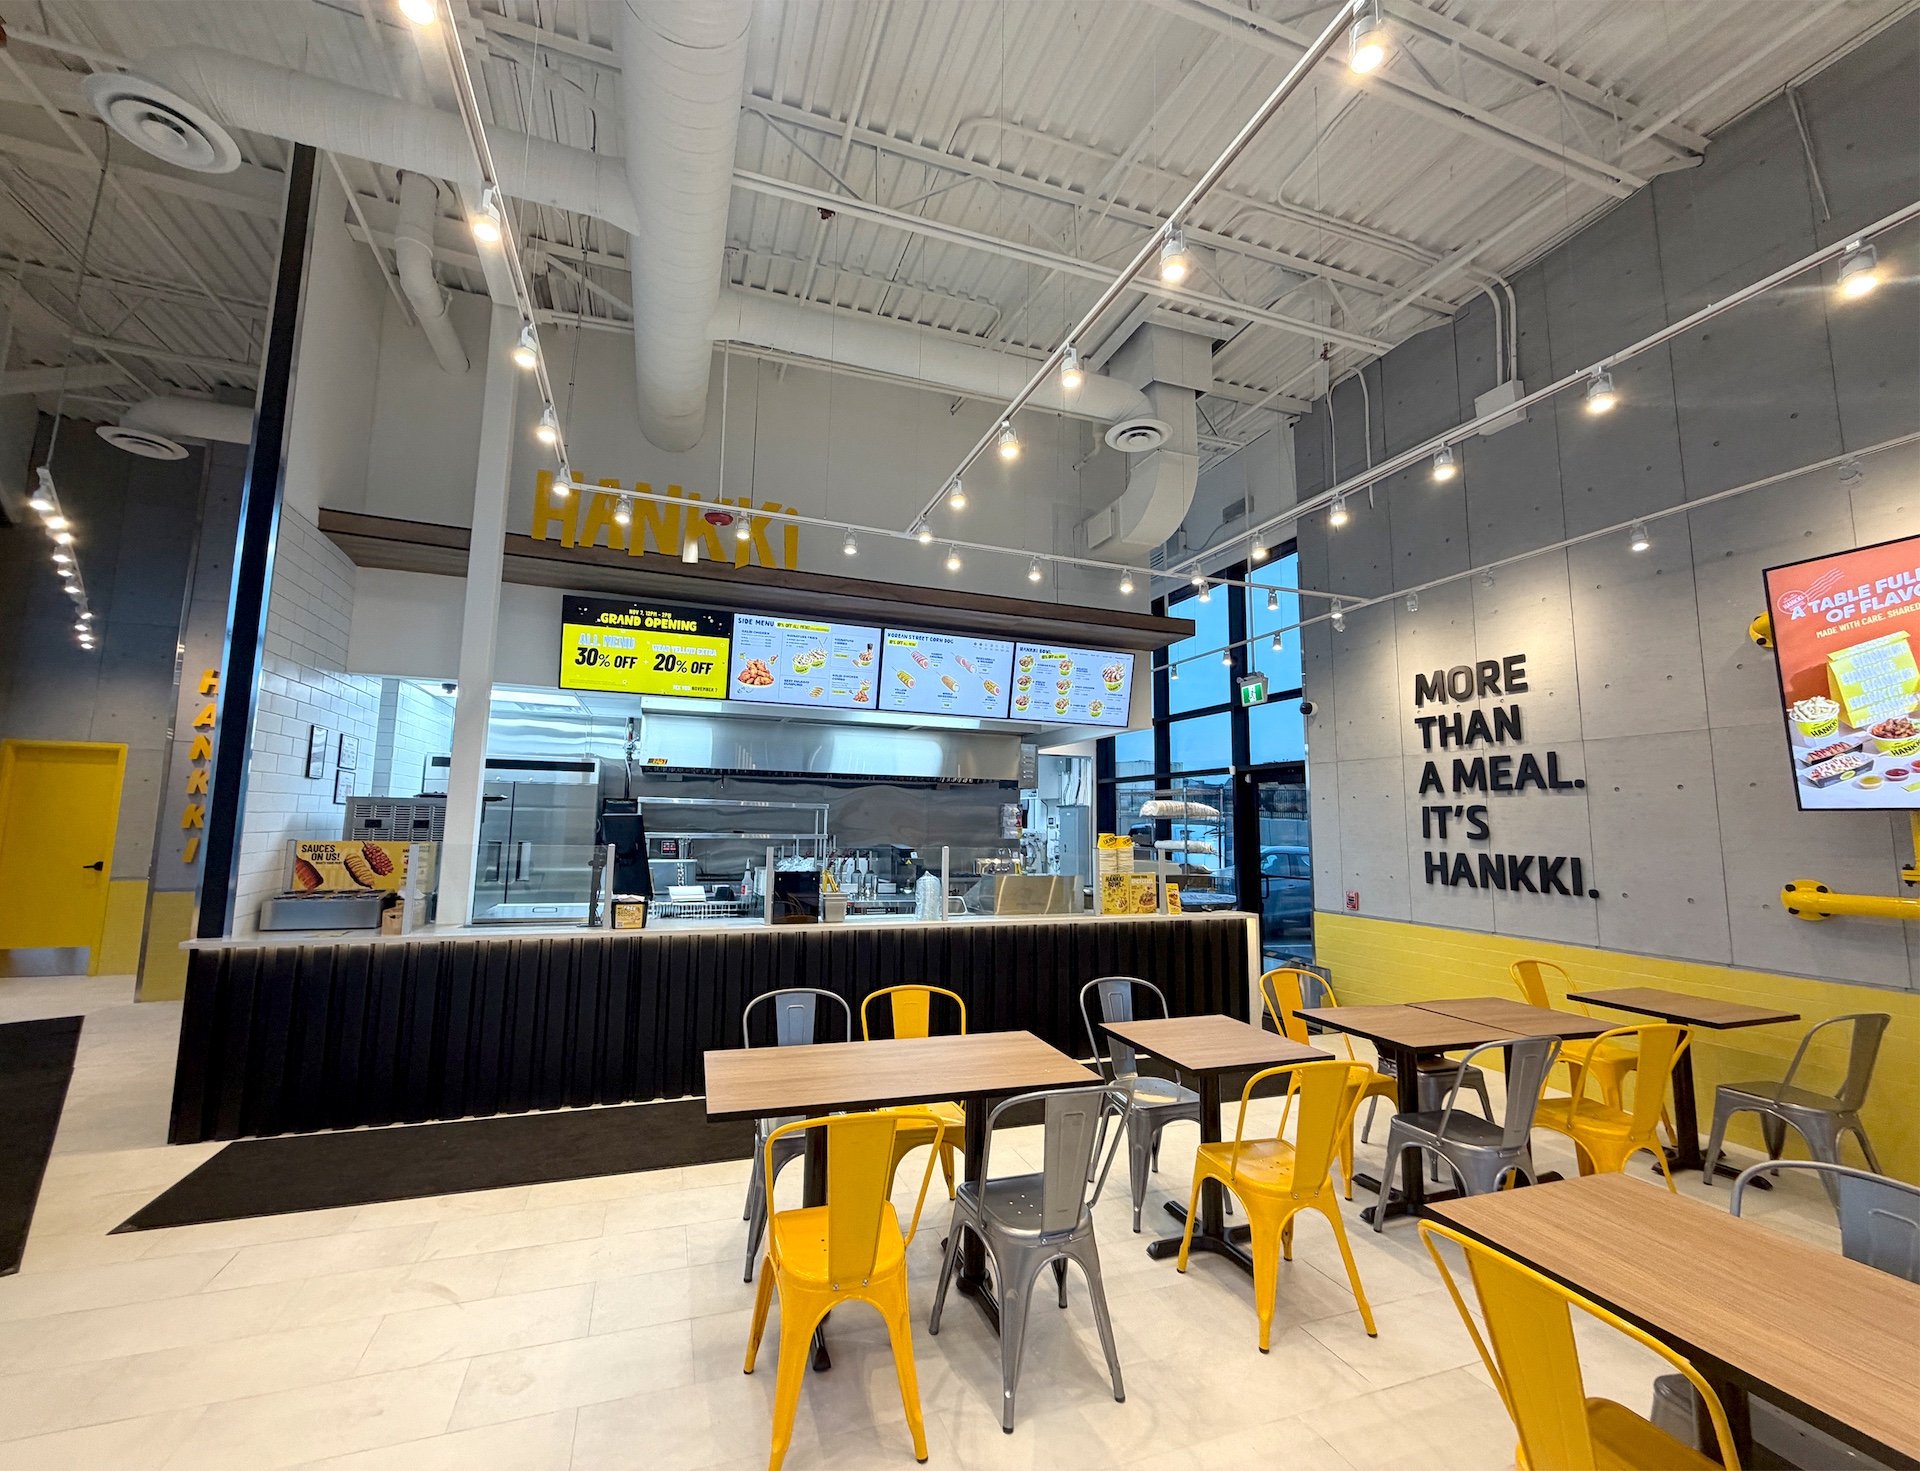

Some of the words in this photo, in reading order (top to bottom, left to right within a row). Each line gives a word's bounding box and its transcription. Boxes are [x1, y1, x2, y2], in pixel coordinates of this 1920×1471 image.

[531, 468, 799, 570] HANKKI
[1791, 606, 1806, 620] A
[1808, 584, 1872, 613] TABLE
[1826, 604, 1856, 622] OF
[600, 613, 642, 627] GRAND
[645, 616, 697, 632] OPENING
[755, 619, 775, 628] MENU
[1816, 626, 1838, 638] MADE
[1839, 620, 1861, 632] WITH
[1861, 613, 1886, 625] CARE.
[578, 633, 600, 647] ALL
[603, 634, 636, 650] MENU
[575, 647, 611, 668] 30%
[614, 655, 638, 669] OFF
[653, 653, 688, 674] 20%
[691, 661, 714, 675] OFF
[1415, 653, 1528, 707] MORE
[1414, 704, 1523, 749] THAN
[180, 667, 220, 864] HANKKI
[1418, 761, 1444, 794] A
[1452, 751, 1585, 792] MEAL.
[1421, 805, 1490, 840] IT'S
[301, 844, 336, 853] SAUCES
[311, 852, 323, 861] ON
[326, 852, 340, 861] US!
[1424, 851, 1600, 899] HANKKI.
